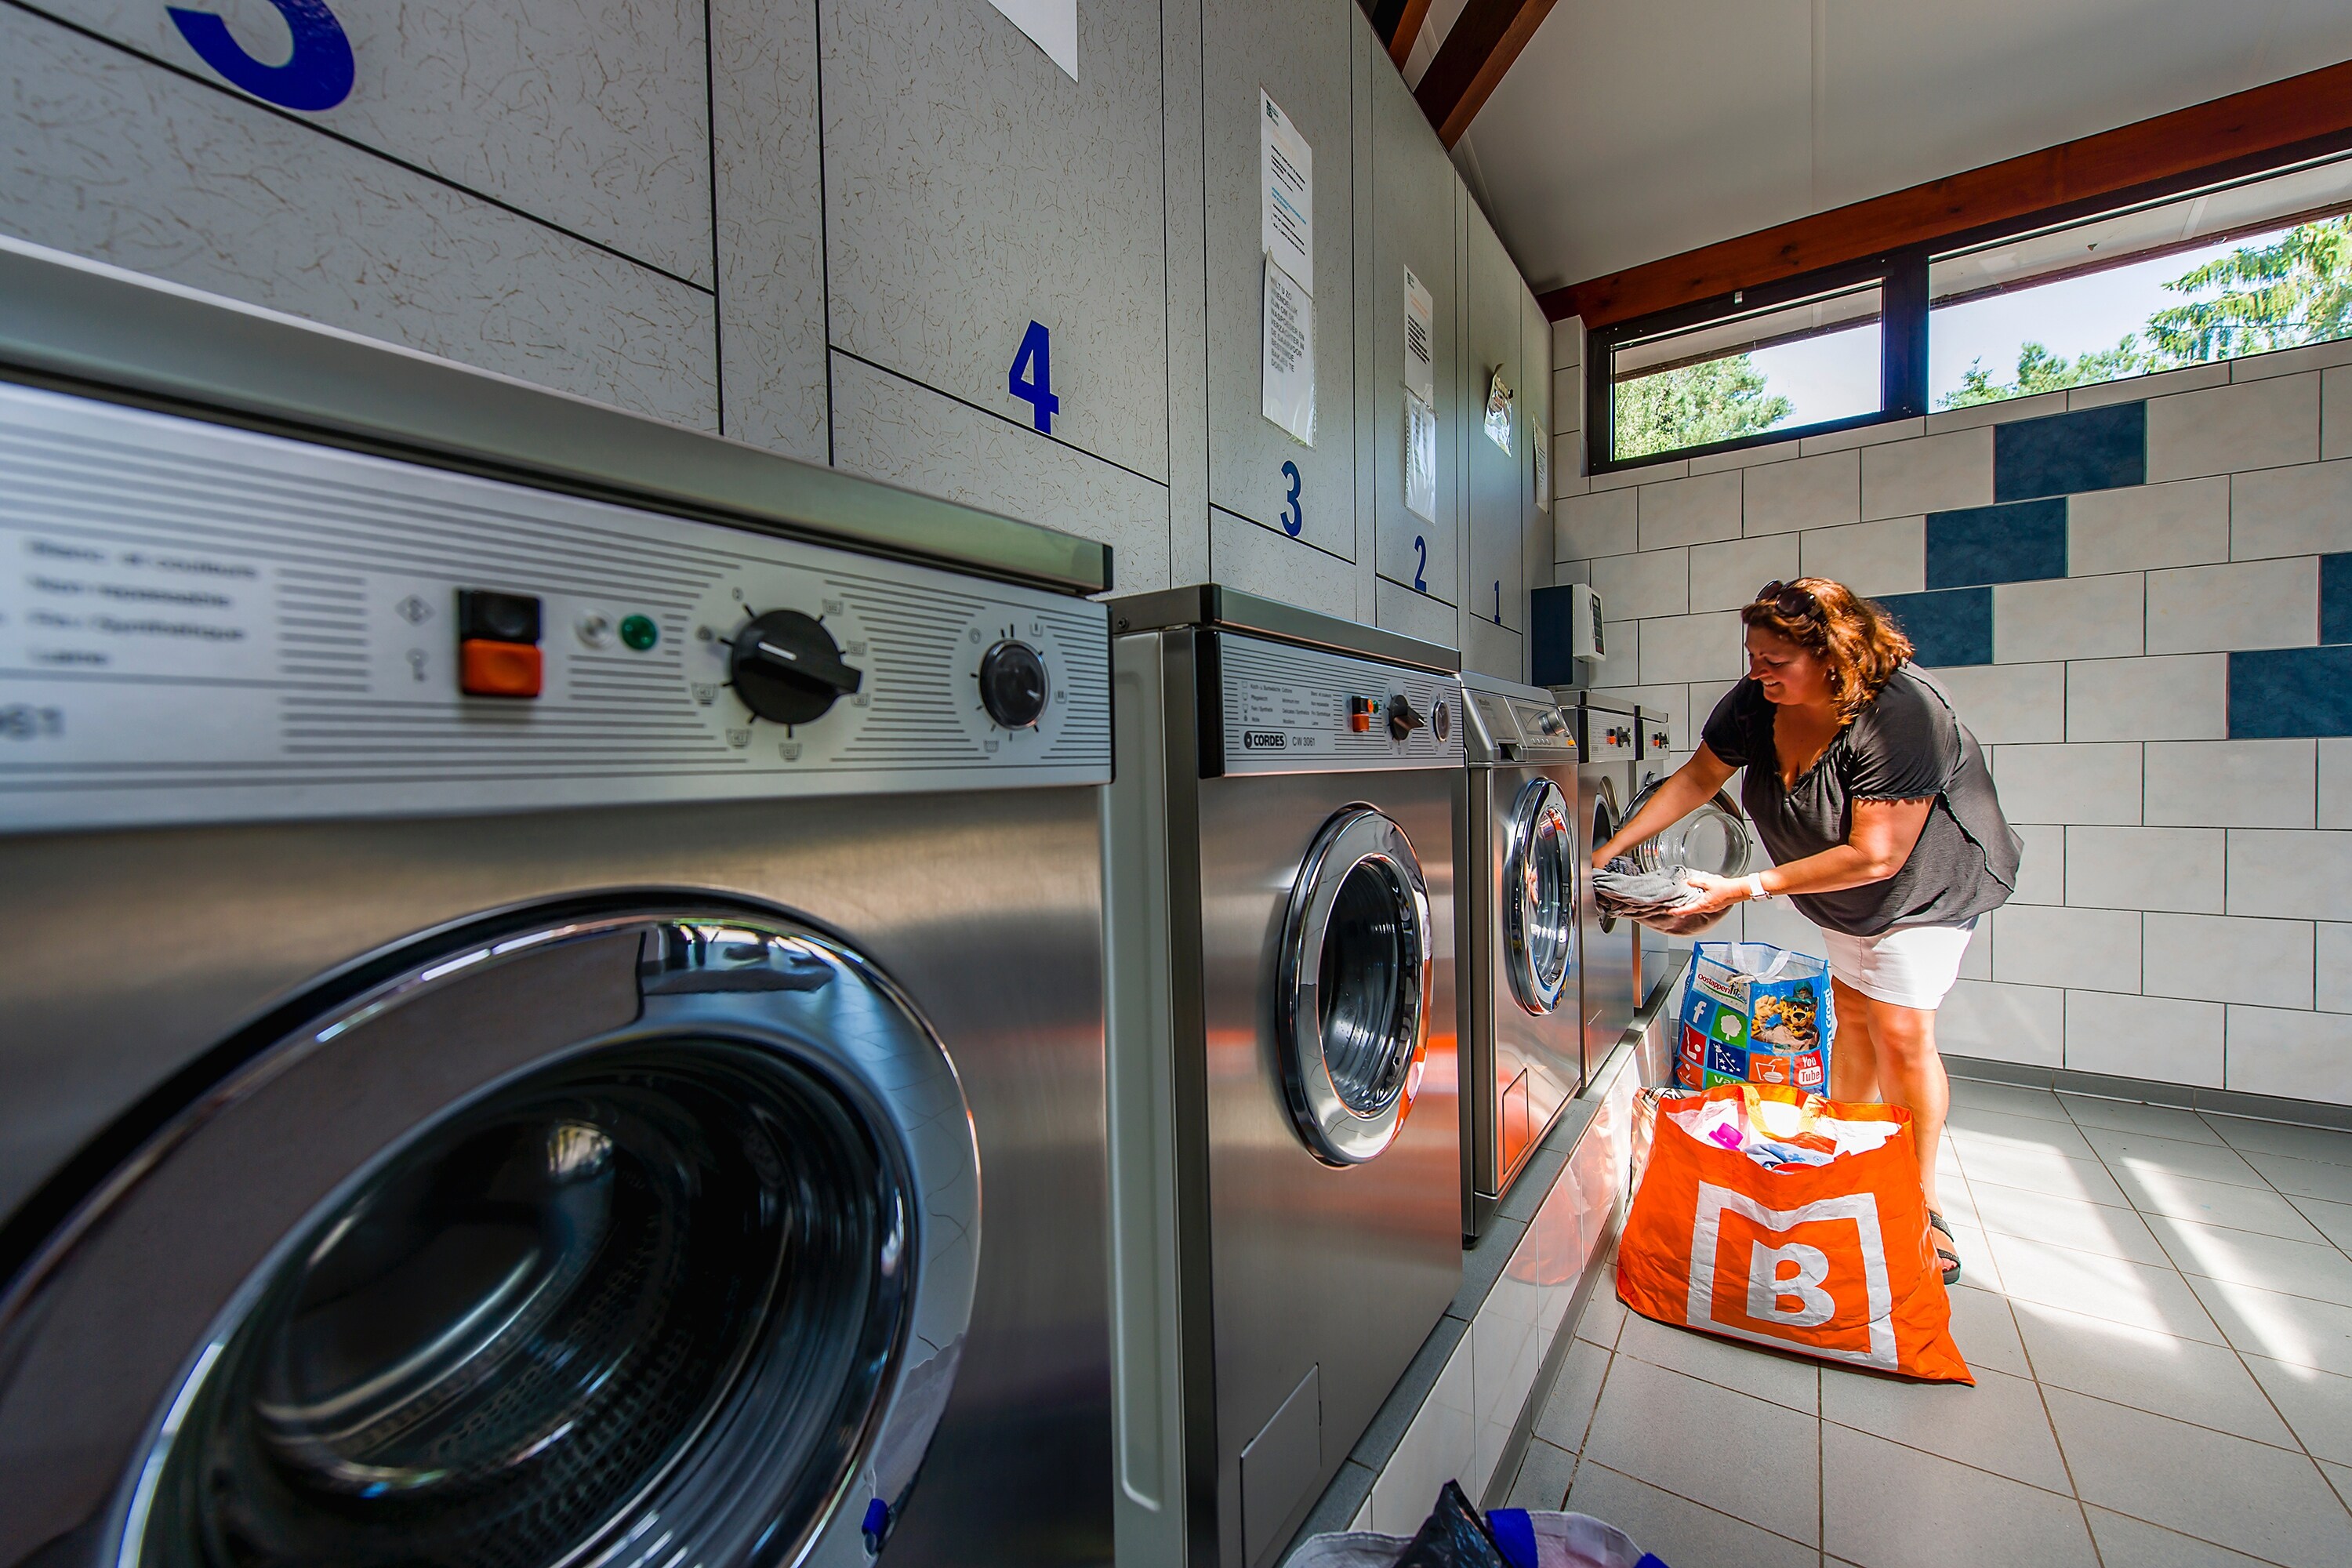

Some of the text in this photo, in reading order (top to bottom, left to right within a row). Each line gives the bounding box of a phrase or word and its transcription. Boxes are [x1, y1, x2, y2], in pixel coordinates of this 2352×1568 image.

[1009, 319, 1060, 436] 4
[1279, 459, 1302, 537] 3
[1414, 535, 1427, 593] 2
[1494, 579, 1501, 625] 1
[1254, 734, 1285, 746] CORDES
[1291, 736, 1302, 746] CW
[1697, 972, 1732, 995] Oostappen
[1800, 1070, 1820, 1083] Tube
[1802, 1056, 1817, 1069] You
[1746, 1239, 1835, 1327] B
